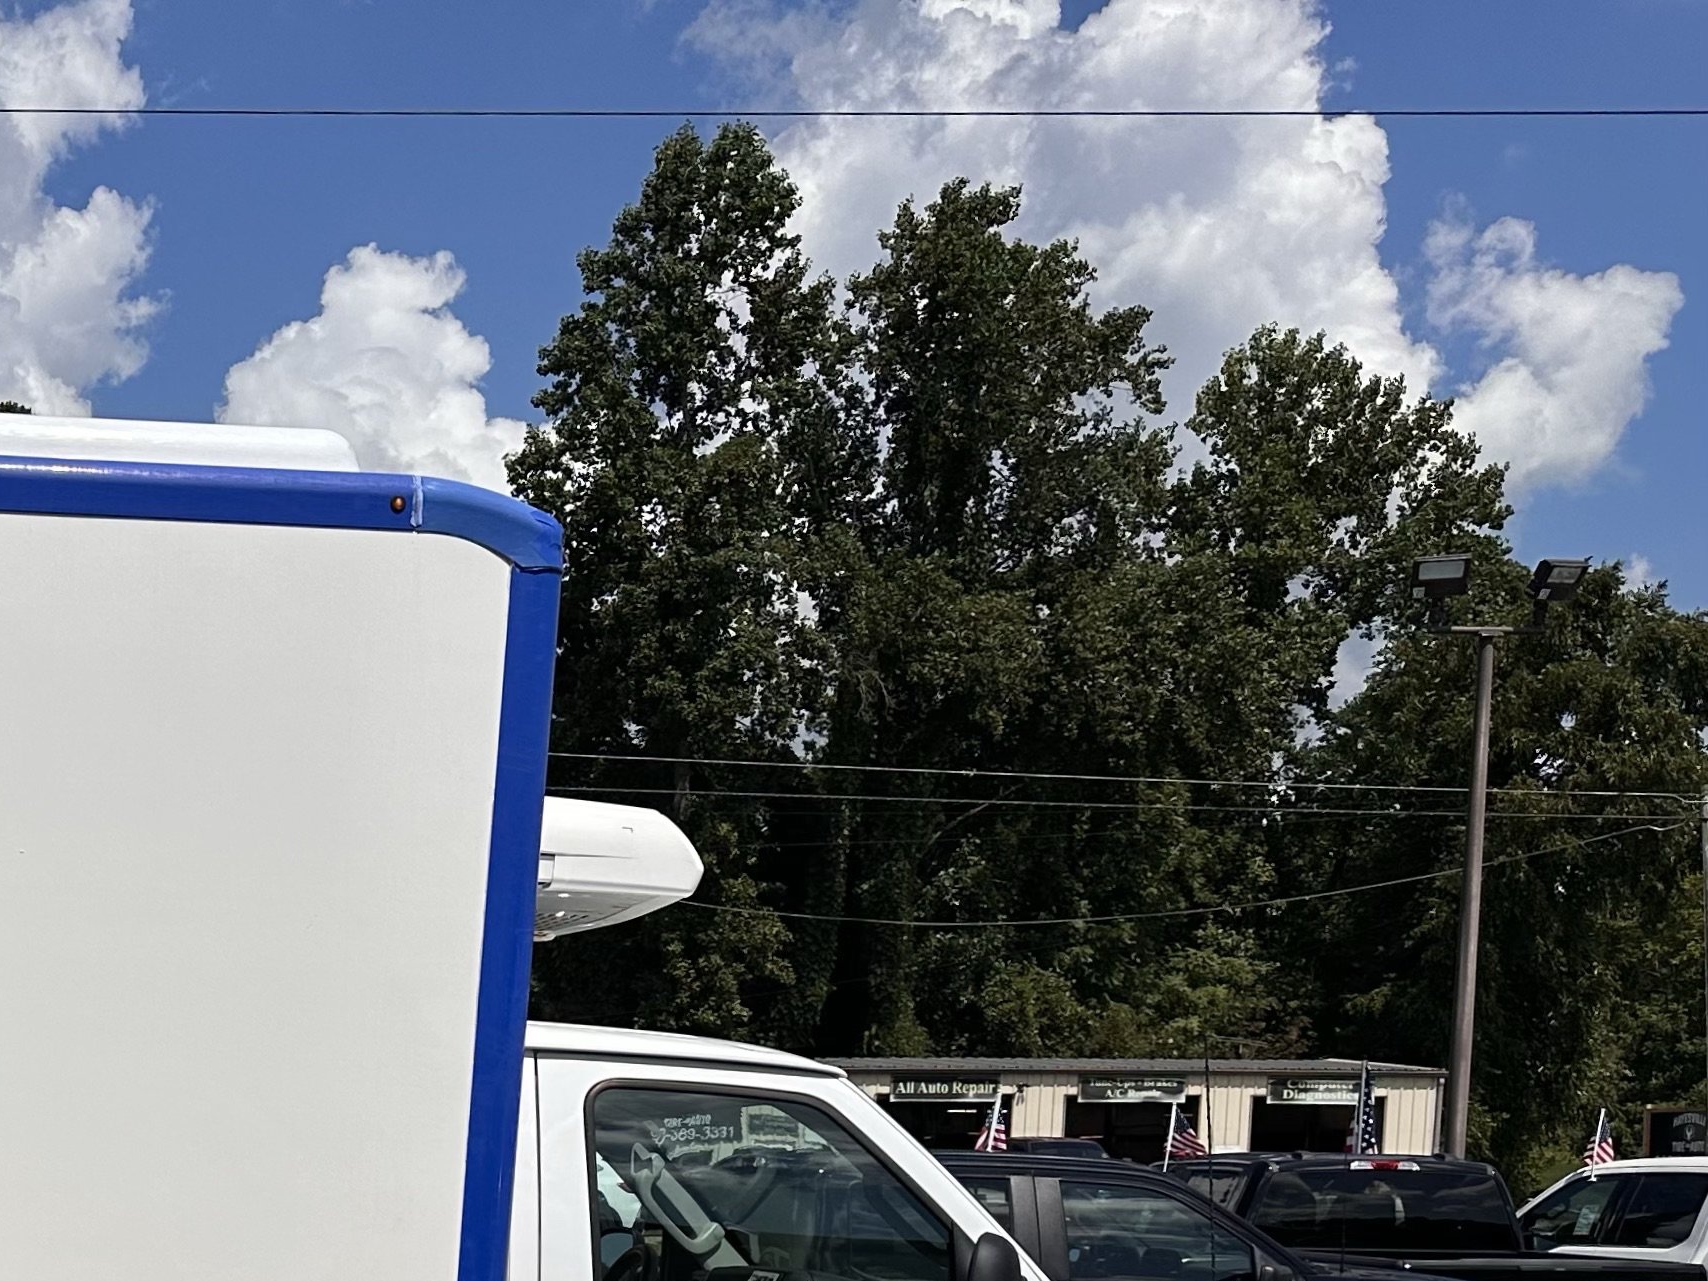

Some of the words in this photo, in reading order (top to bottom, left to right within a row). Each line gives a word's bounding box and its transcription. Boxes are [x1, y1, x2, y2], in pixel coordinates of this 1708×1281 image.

[895, 1081, 915, 1094] All
[917, 1081, 949, 1094] Auto
[952, 1081, 996, 1097] Repair
[1105, 1089, 1125, 1098] A/C
